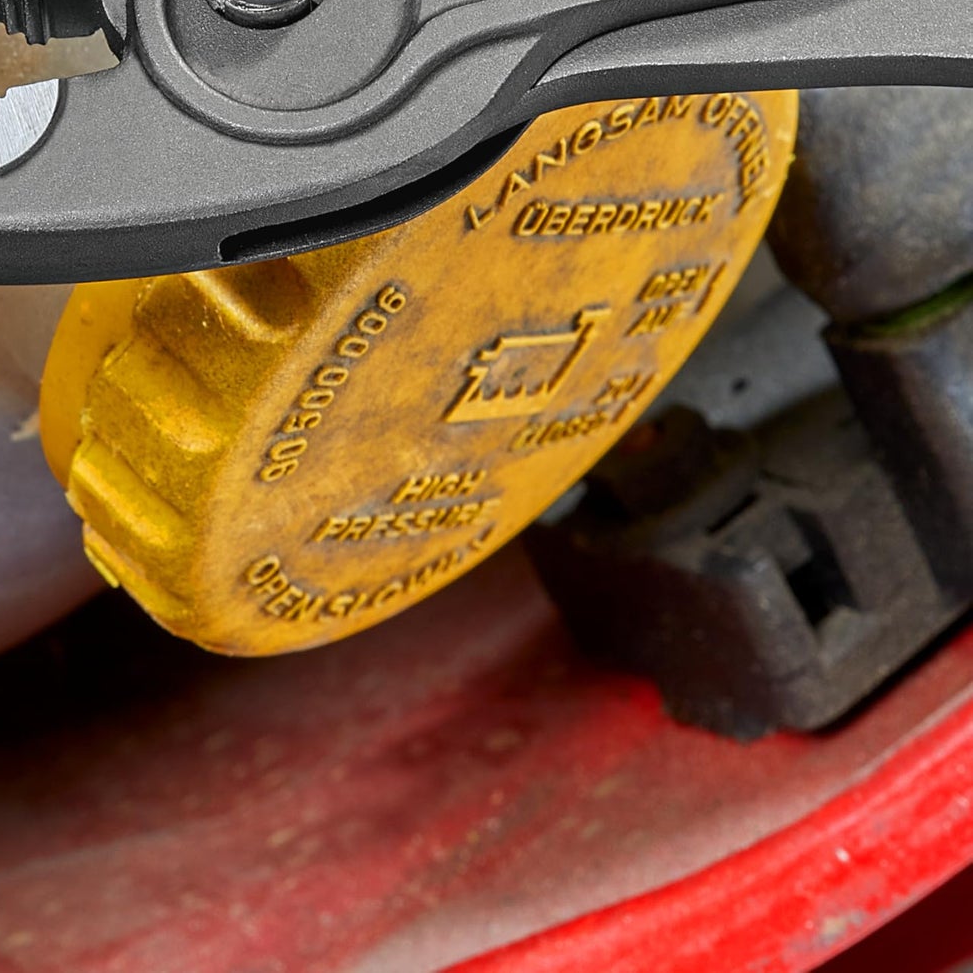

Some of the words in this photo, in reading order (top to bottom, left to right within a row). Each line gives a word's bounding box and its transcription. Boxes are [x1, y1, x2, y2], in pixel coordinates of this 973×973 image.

[466, 95, 692, 231] LANGSAM
[515, 193, 725, 236] ÜBERDRUCK
[391, 467, 488, 505] HIGH
[311, 497, 502, 542] PRESSURE
[244, 552, 327, 623] OPEN
